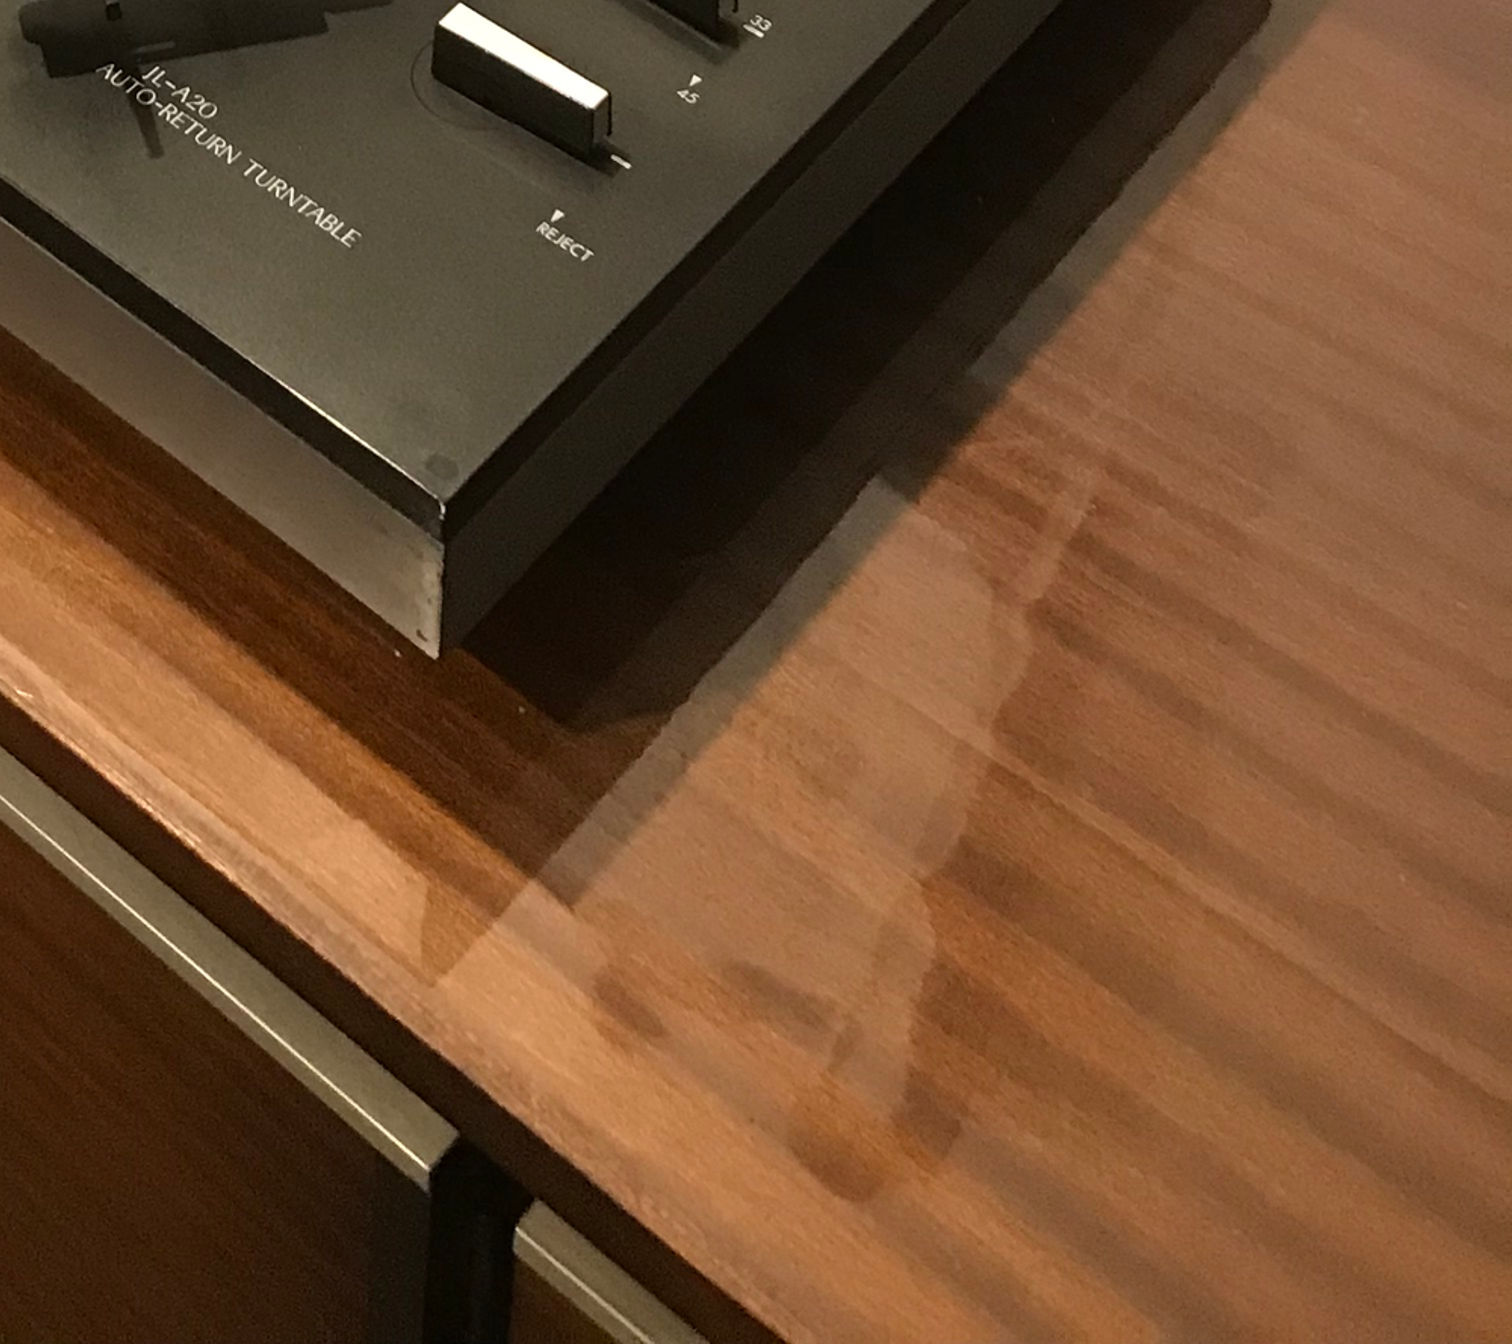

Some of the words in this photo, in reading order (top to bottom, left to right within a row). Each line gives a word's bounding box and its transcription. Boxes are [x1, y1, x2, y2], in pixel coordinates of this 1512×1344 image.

[750, 14, 773, 32] 33
[141, 65, 219, 119] JL-A20
[676, 90, 700, 104] 45
[96, 63, 242, 165] AUTO-RETURN
[243, 158, 362, 249] TURNTABLE
[536, 221, 595, 262] REJECT
